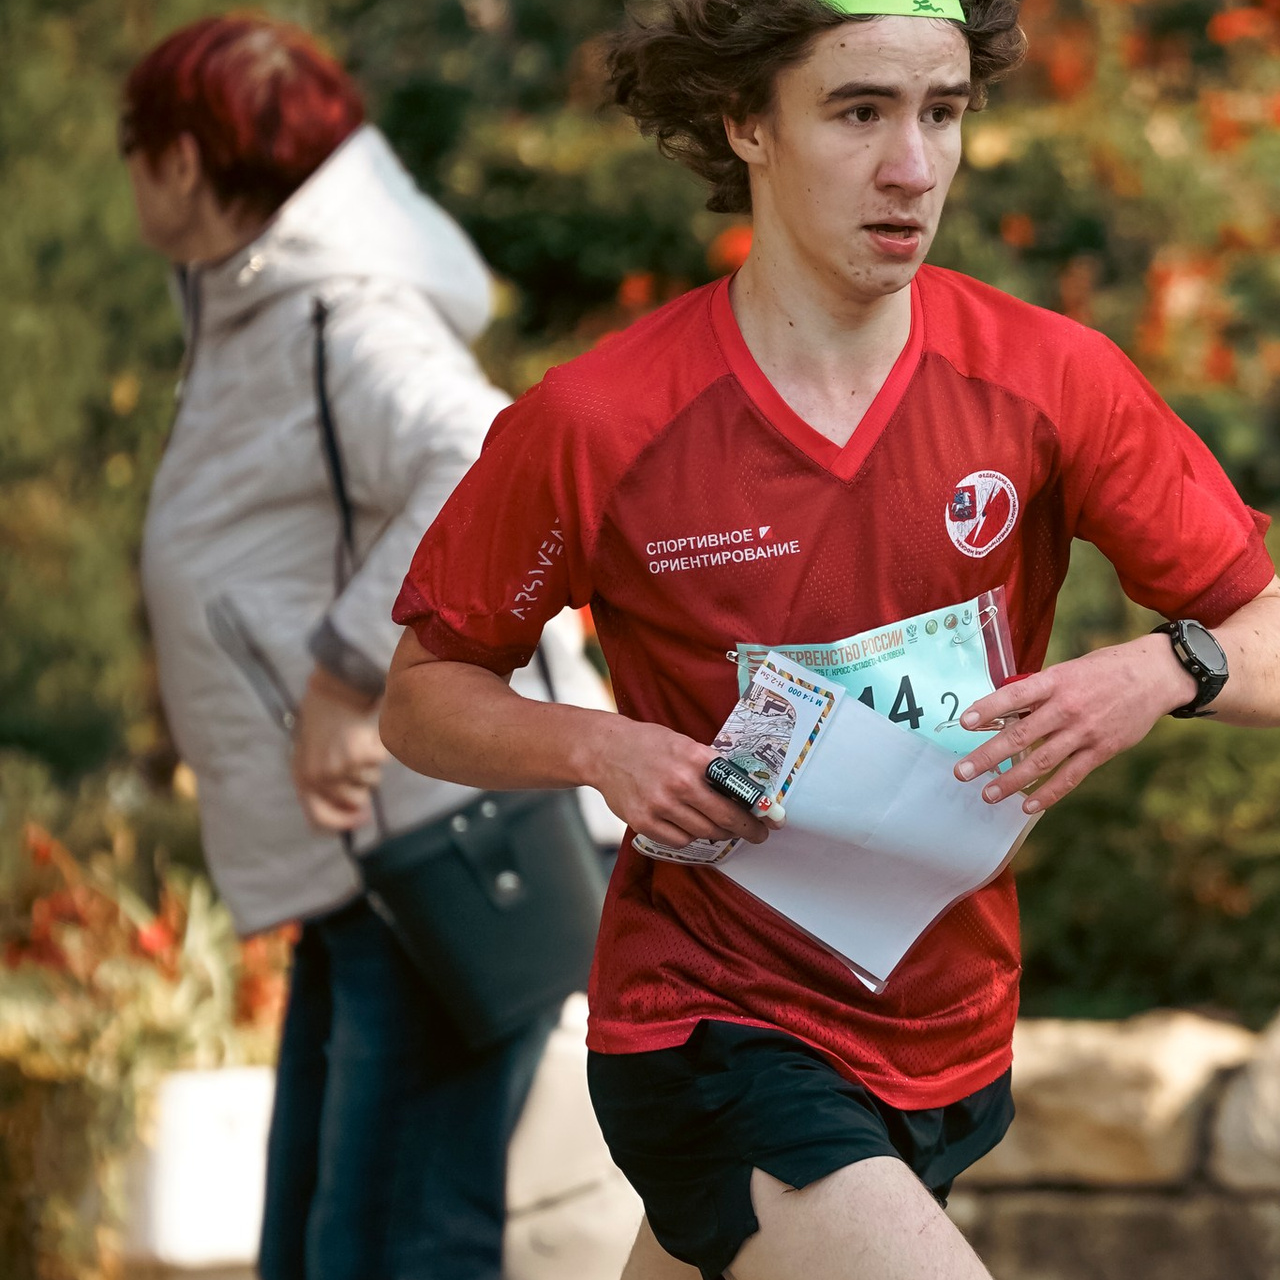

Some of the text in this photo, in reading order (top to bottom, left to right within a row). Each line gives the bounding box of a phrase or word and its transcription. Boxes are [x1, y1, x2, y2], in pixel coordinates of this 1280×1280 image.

[646, 528, 754, 555] СПОРТИВНОЕ
[649, 540, 801, 574] ОРИЕНТИРОВАНИЕ
[861, 628, 904, 658] РОССИИ
[881, 647, 906, 662] ЧЕЛОВЕКА
[788, 686, 802, 697] 000
[802, 693, 814, 703] 1:4
